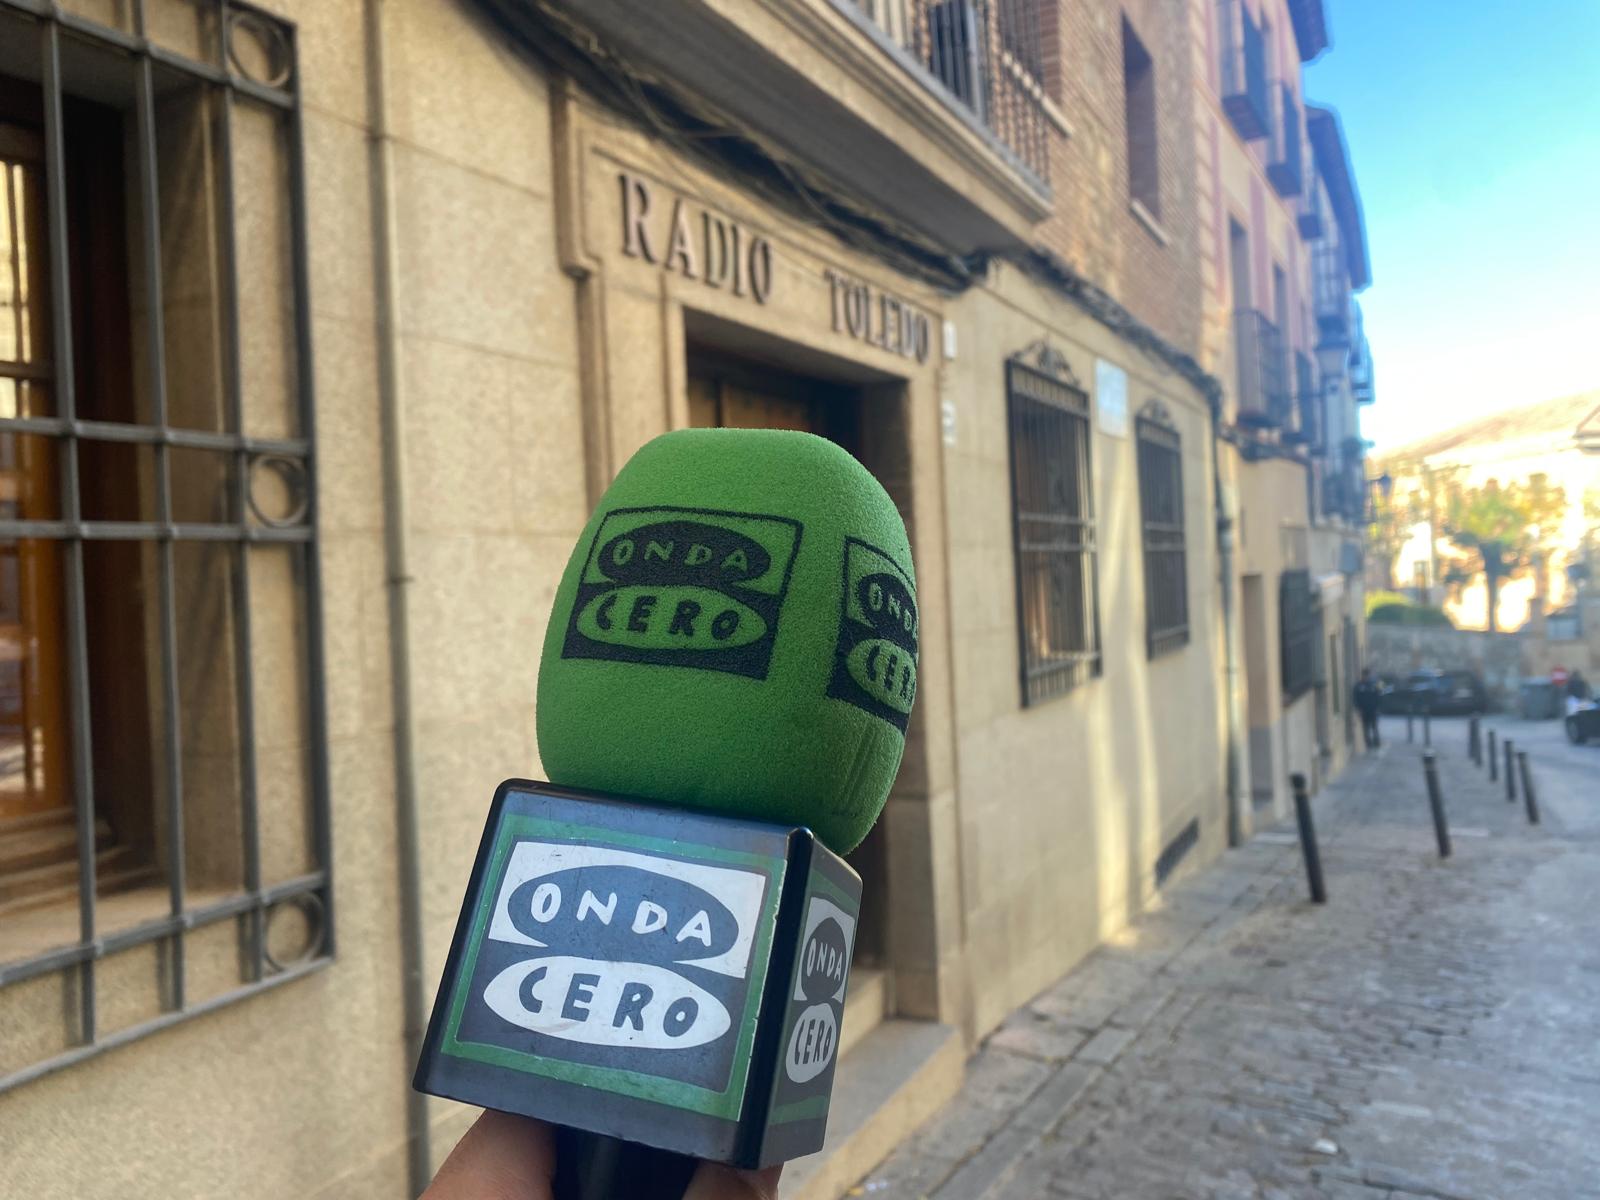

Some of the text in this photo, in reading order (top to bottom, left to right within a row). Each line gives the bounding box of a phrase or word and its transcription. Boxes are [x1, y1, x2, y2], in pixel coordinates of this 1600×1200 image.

[618, 174, 931, 365] RADIO TOLEDO
[612, 538, 750, 573] ONDA
[596, 594, 740, 641] CERO
[531, 882, 712, 948] ONDA
[807, 937, 843, 982] ONDA
[518, 965, 699, 1038] CERO
[794, 1018, 832, 1065] CERO
